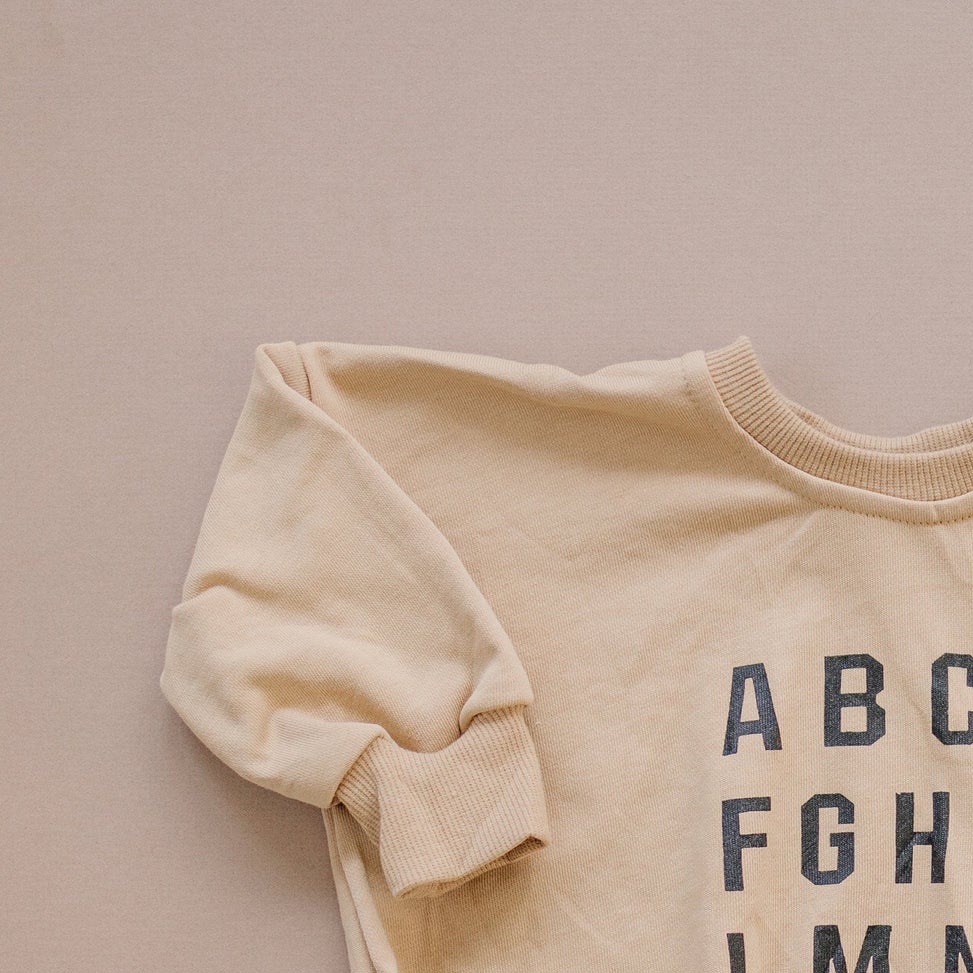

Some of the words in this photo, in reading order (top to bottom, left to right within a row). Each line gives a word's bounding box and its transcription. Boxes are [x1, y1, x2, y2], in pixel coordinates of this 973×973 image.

[722, 662, 783, 757] A
[823, 653, 886, 748] B
[721, 796, 772, 892] F
[800, 792, 855, 886] G
[894, 791, 950, 884] H
